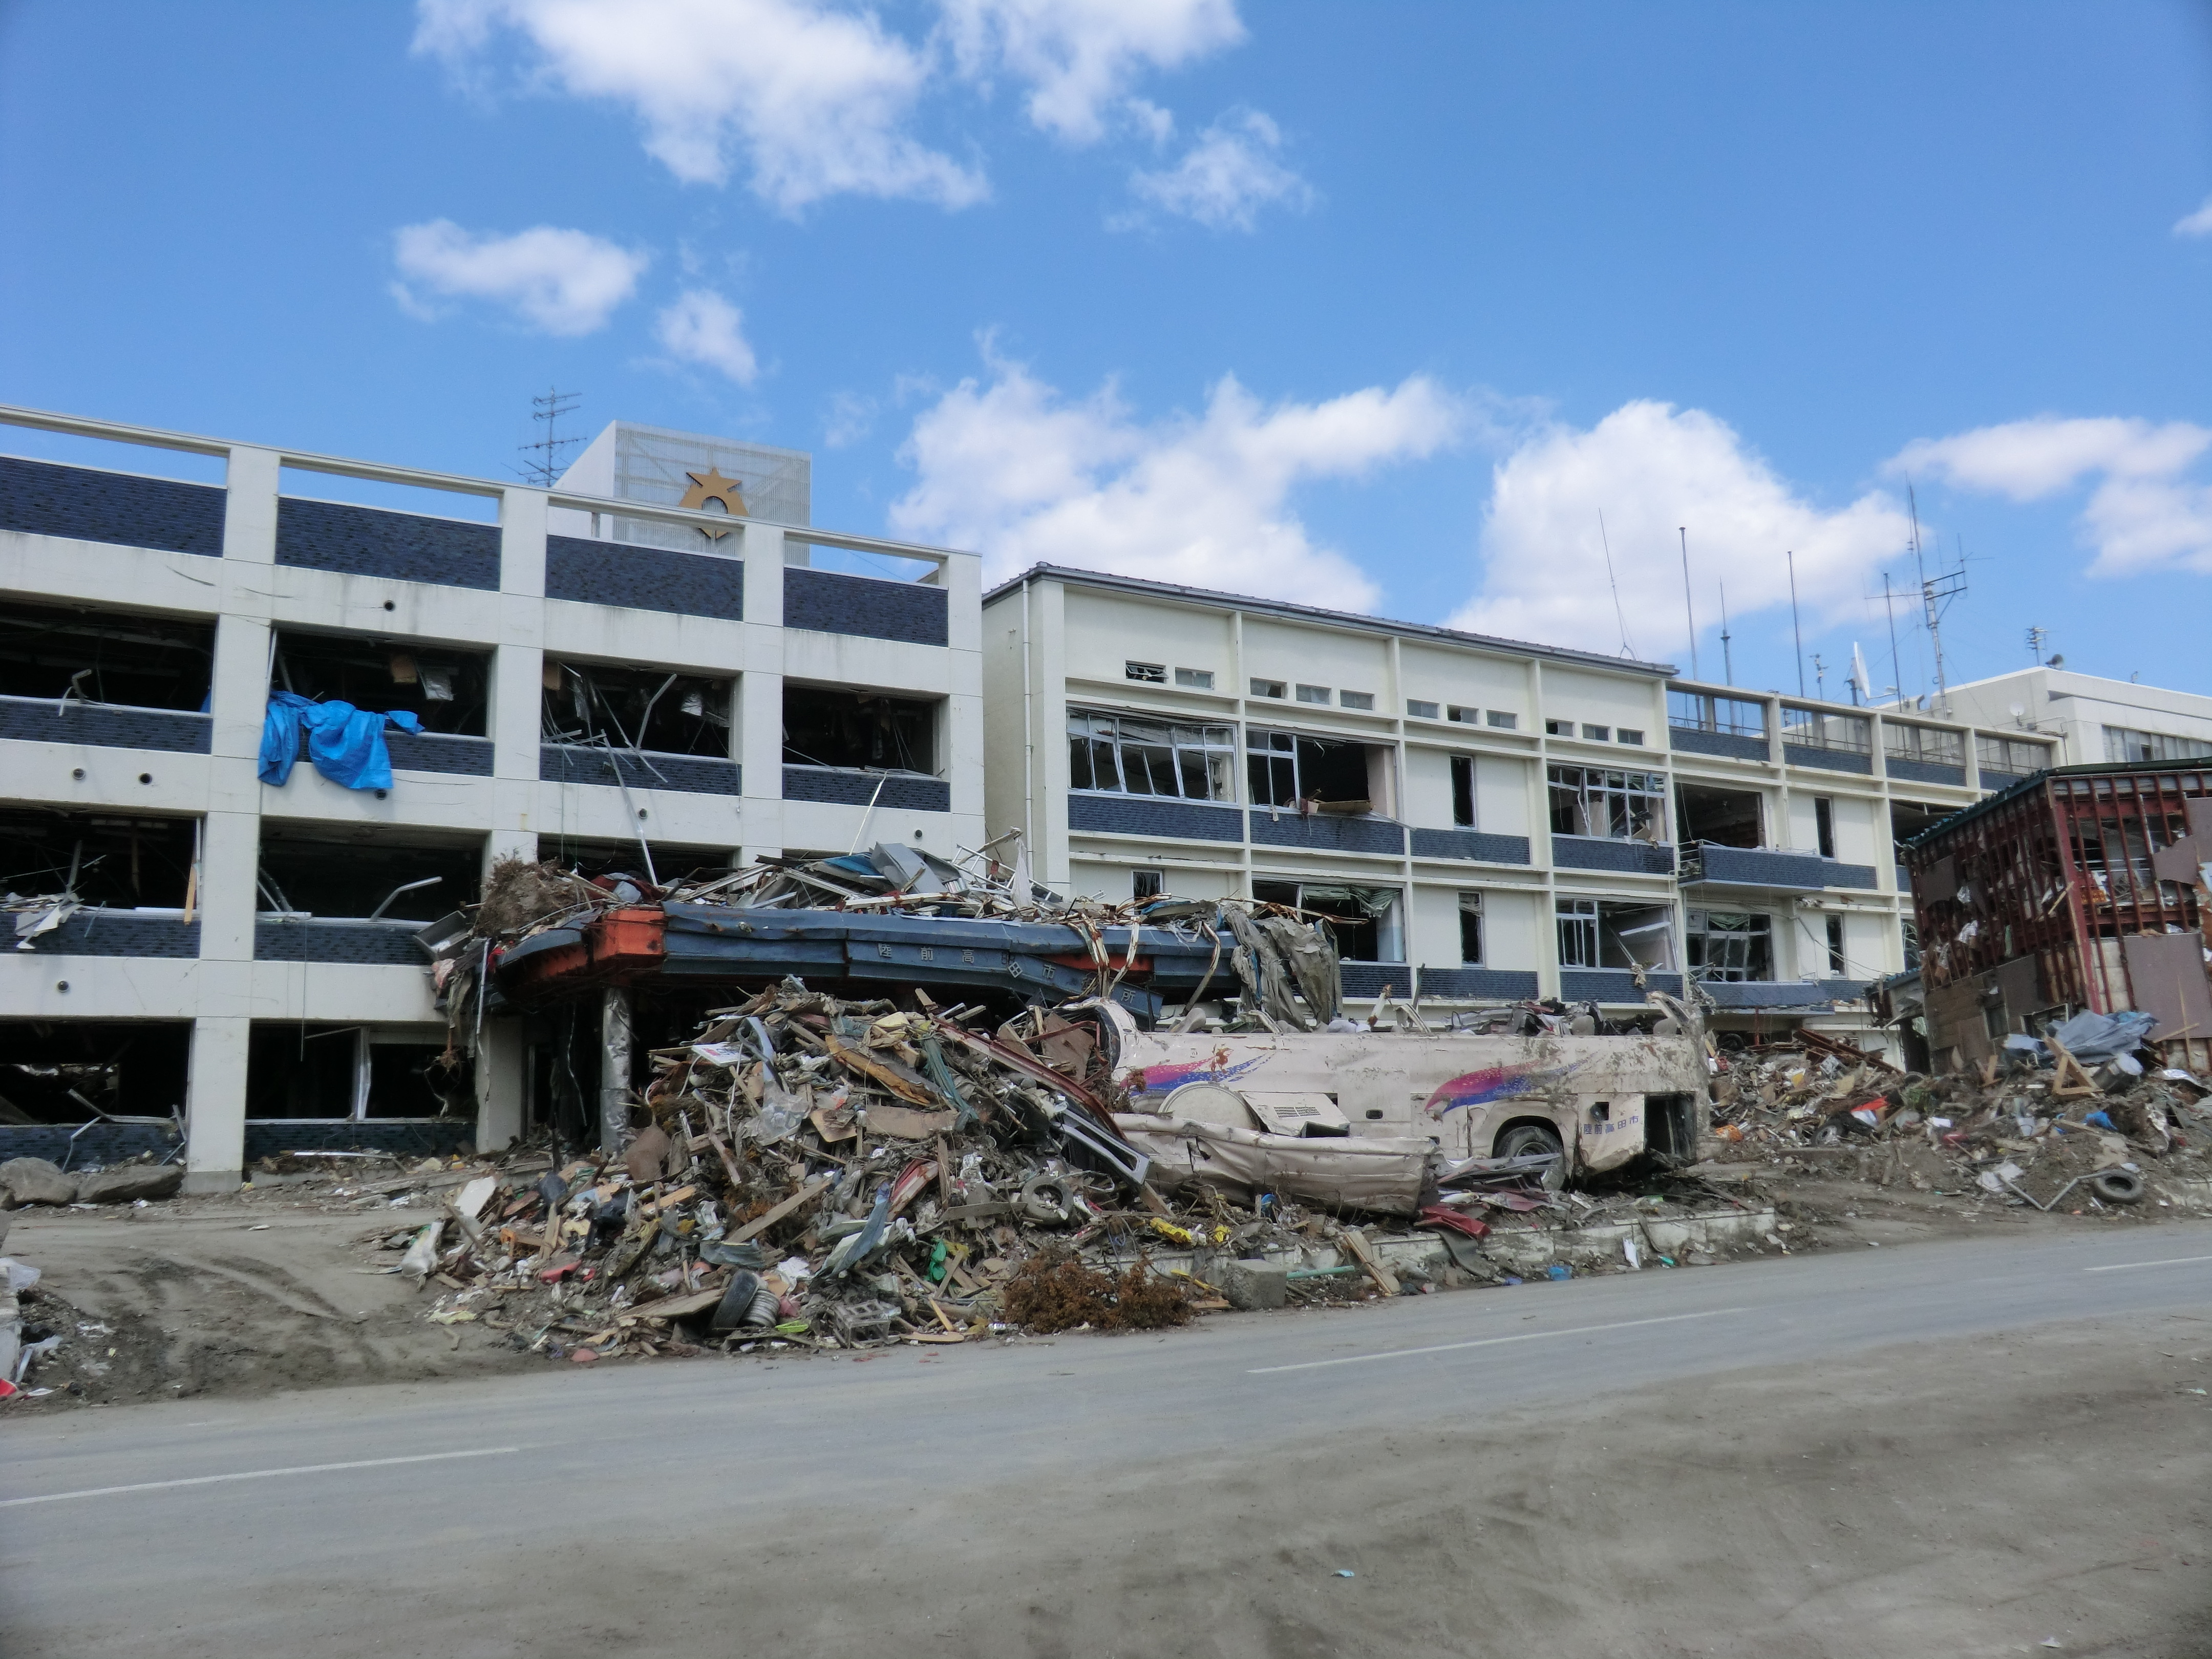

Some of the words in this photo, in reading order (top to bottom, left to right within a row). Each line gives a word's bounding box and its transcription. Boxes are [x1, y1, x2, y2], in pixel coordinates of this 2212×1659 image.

[878, 943, 1136, 1003] 陸前高田市所
[1584, 1116, 1639, 1134] 陸前高田市
